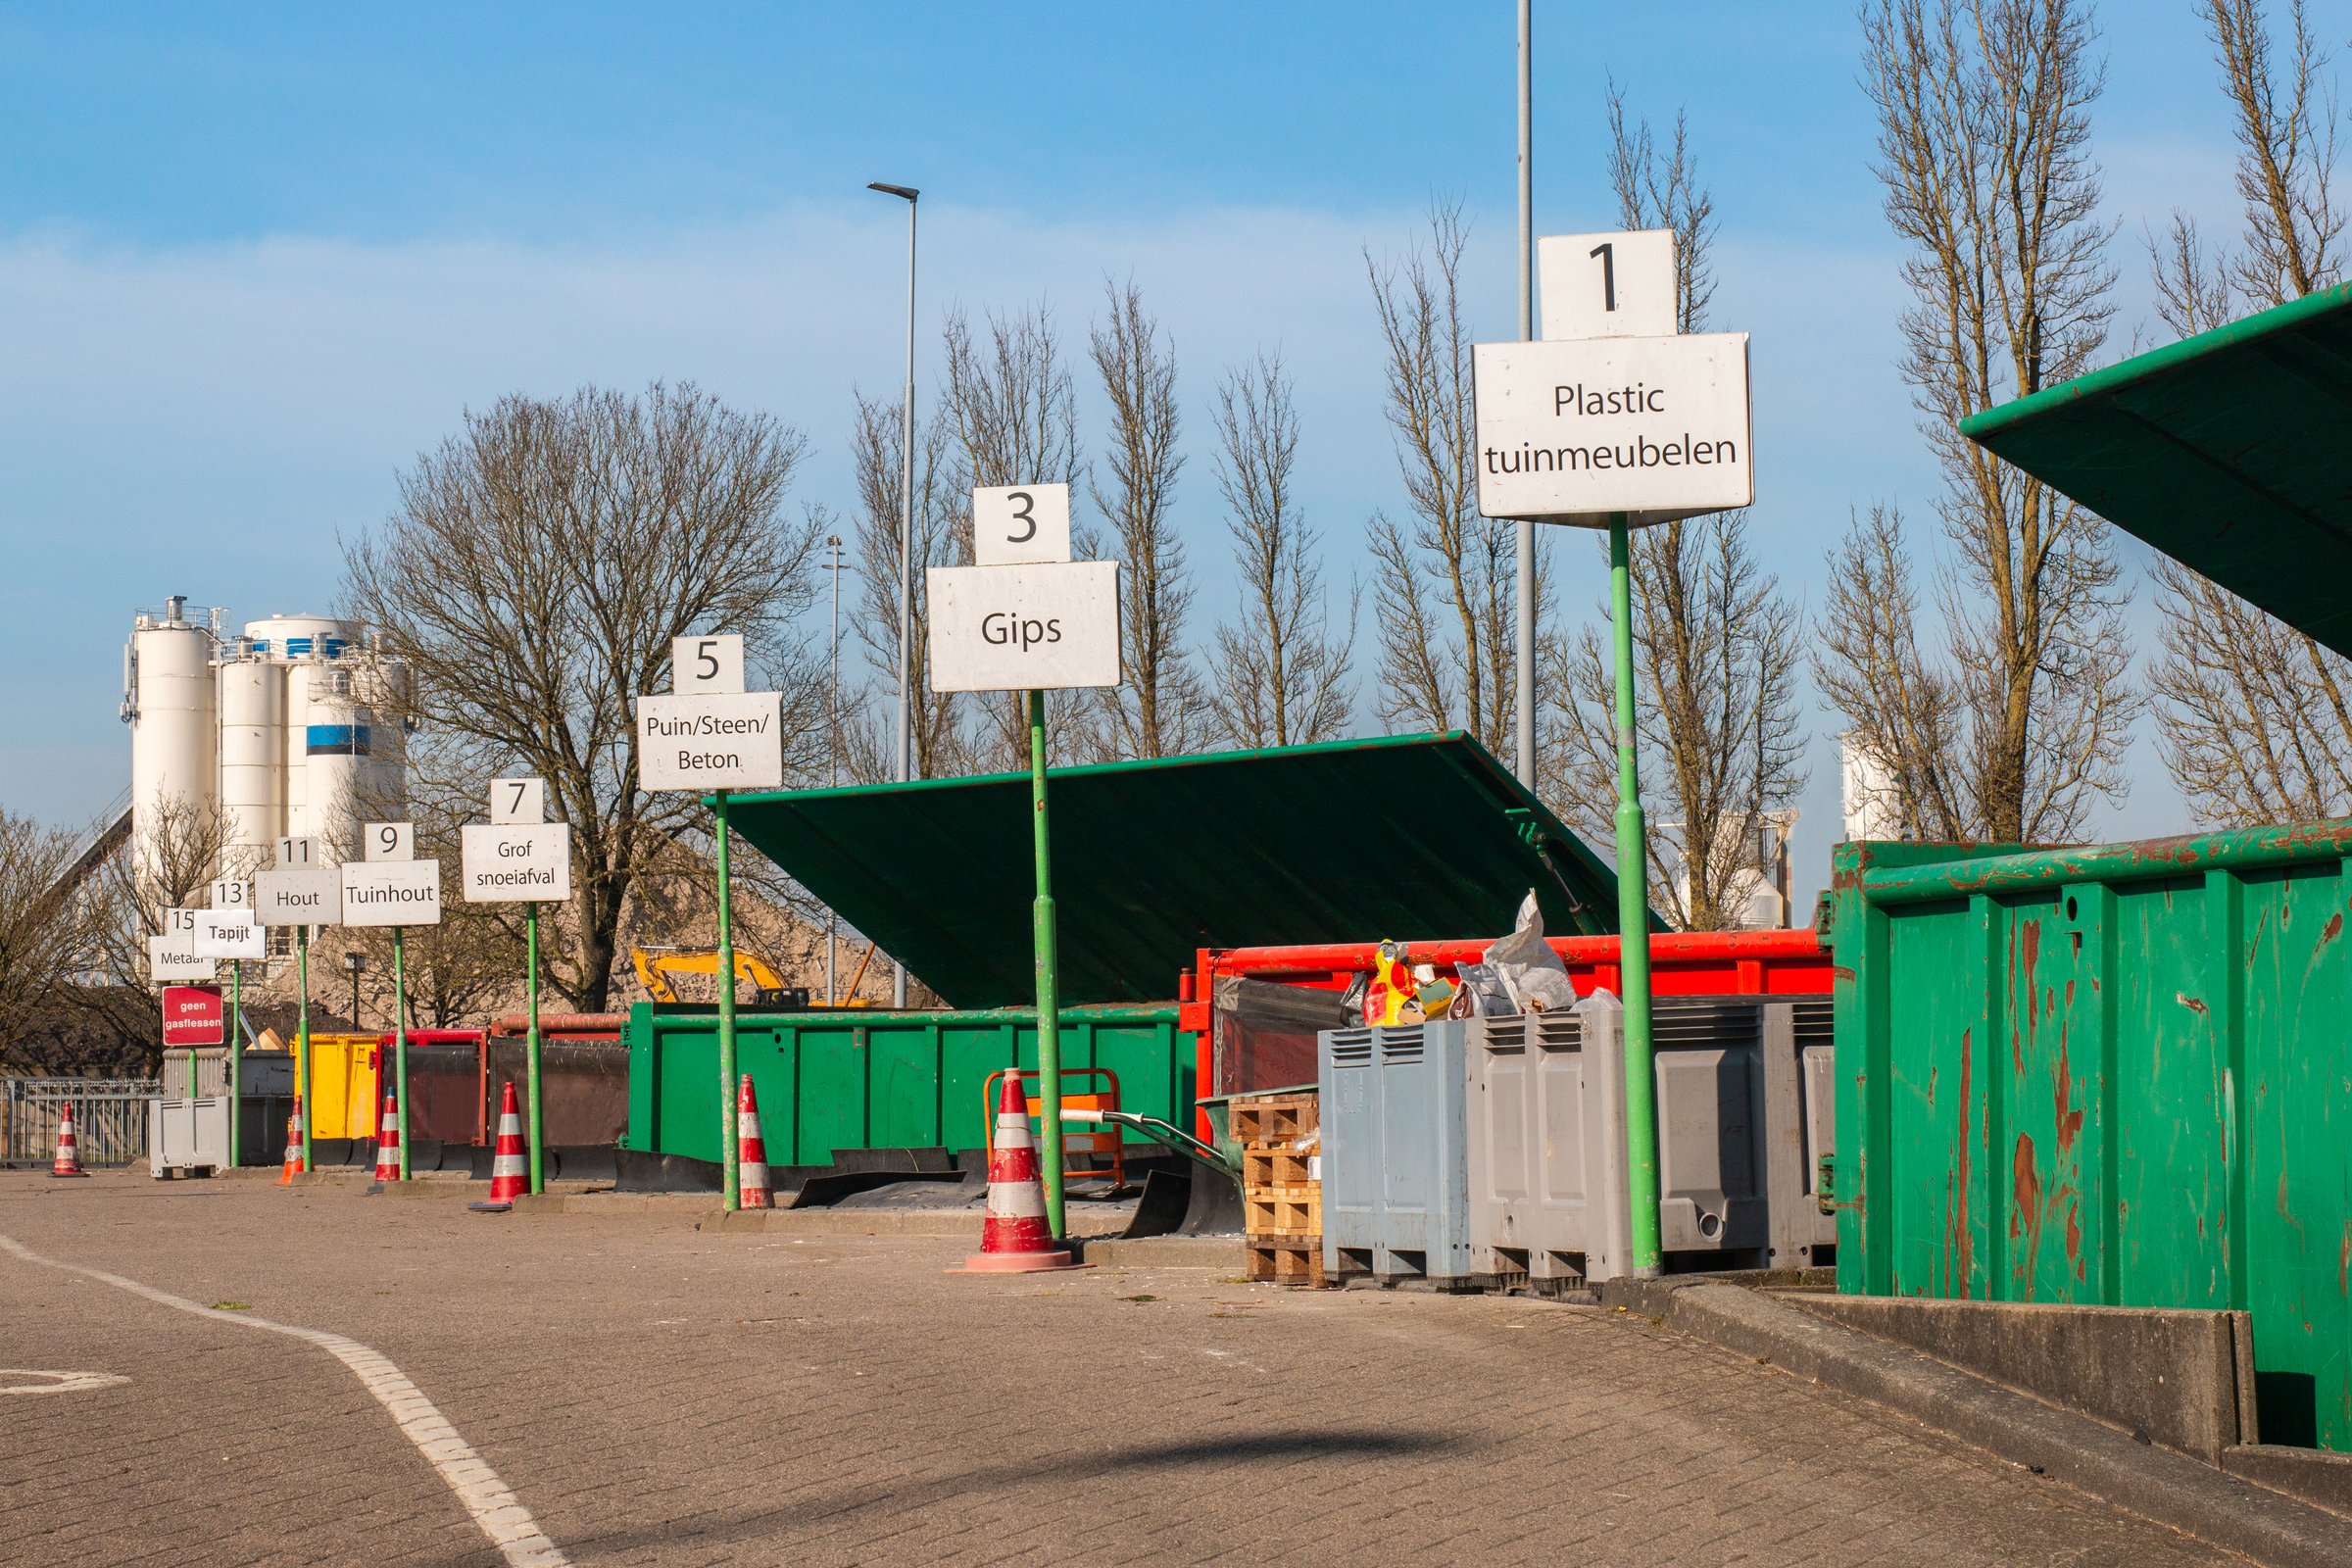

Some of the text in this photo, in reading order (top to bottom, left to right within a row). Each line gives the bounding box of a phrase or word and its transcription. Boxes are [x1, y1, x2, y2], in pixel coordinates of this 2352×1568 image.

[1590, 244, 1619, 312] 1
[1555, 383, 1664, 416] Plastic
[1484, 434, 1736, 473] tuinmeubelen
[1007, 492, 1036, 543] 3
[982, 612, 1060, 653] Gips
[697, 645, 718, 679] 5
[647, 714, 768, 737] Puin/Steen/
[678, 751, 739, 770] Beton
[508, 785, 526, 813] 7
[282, 839, 309, 863] 11
[380, 827, 398, 854] 9
[498, 841, 532, 857] Grof
[476, 868, 554, 886] snoeiafval
[218, 883, 242, 904] 13
[276, 891, 319, 906] Hout
[346, 885, 433, 904] Tuinhout
[173, 910, 194, 930] 15
[209, 925, 250, 944] Tapijt
[180, 1002, 207, 1013] geen
[165, 1019, 221, 1031] gasflessen
